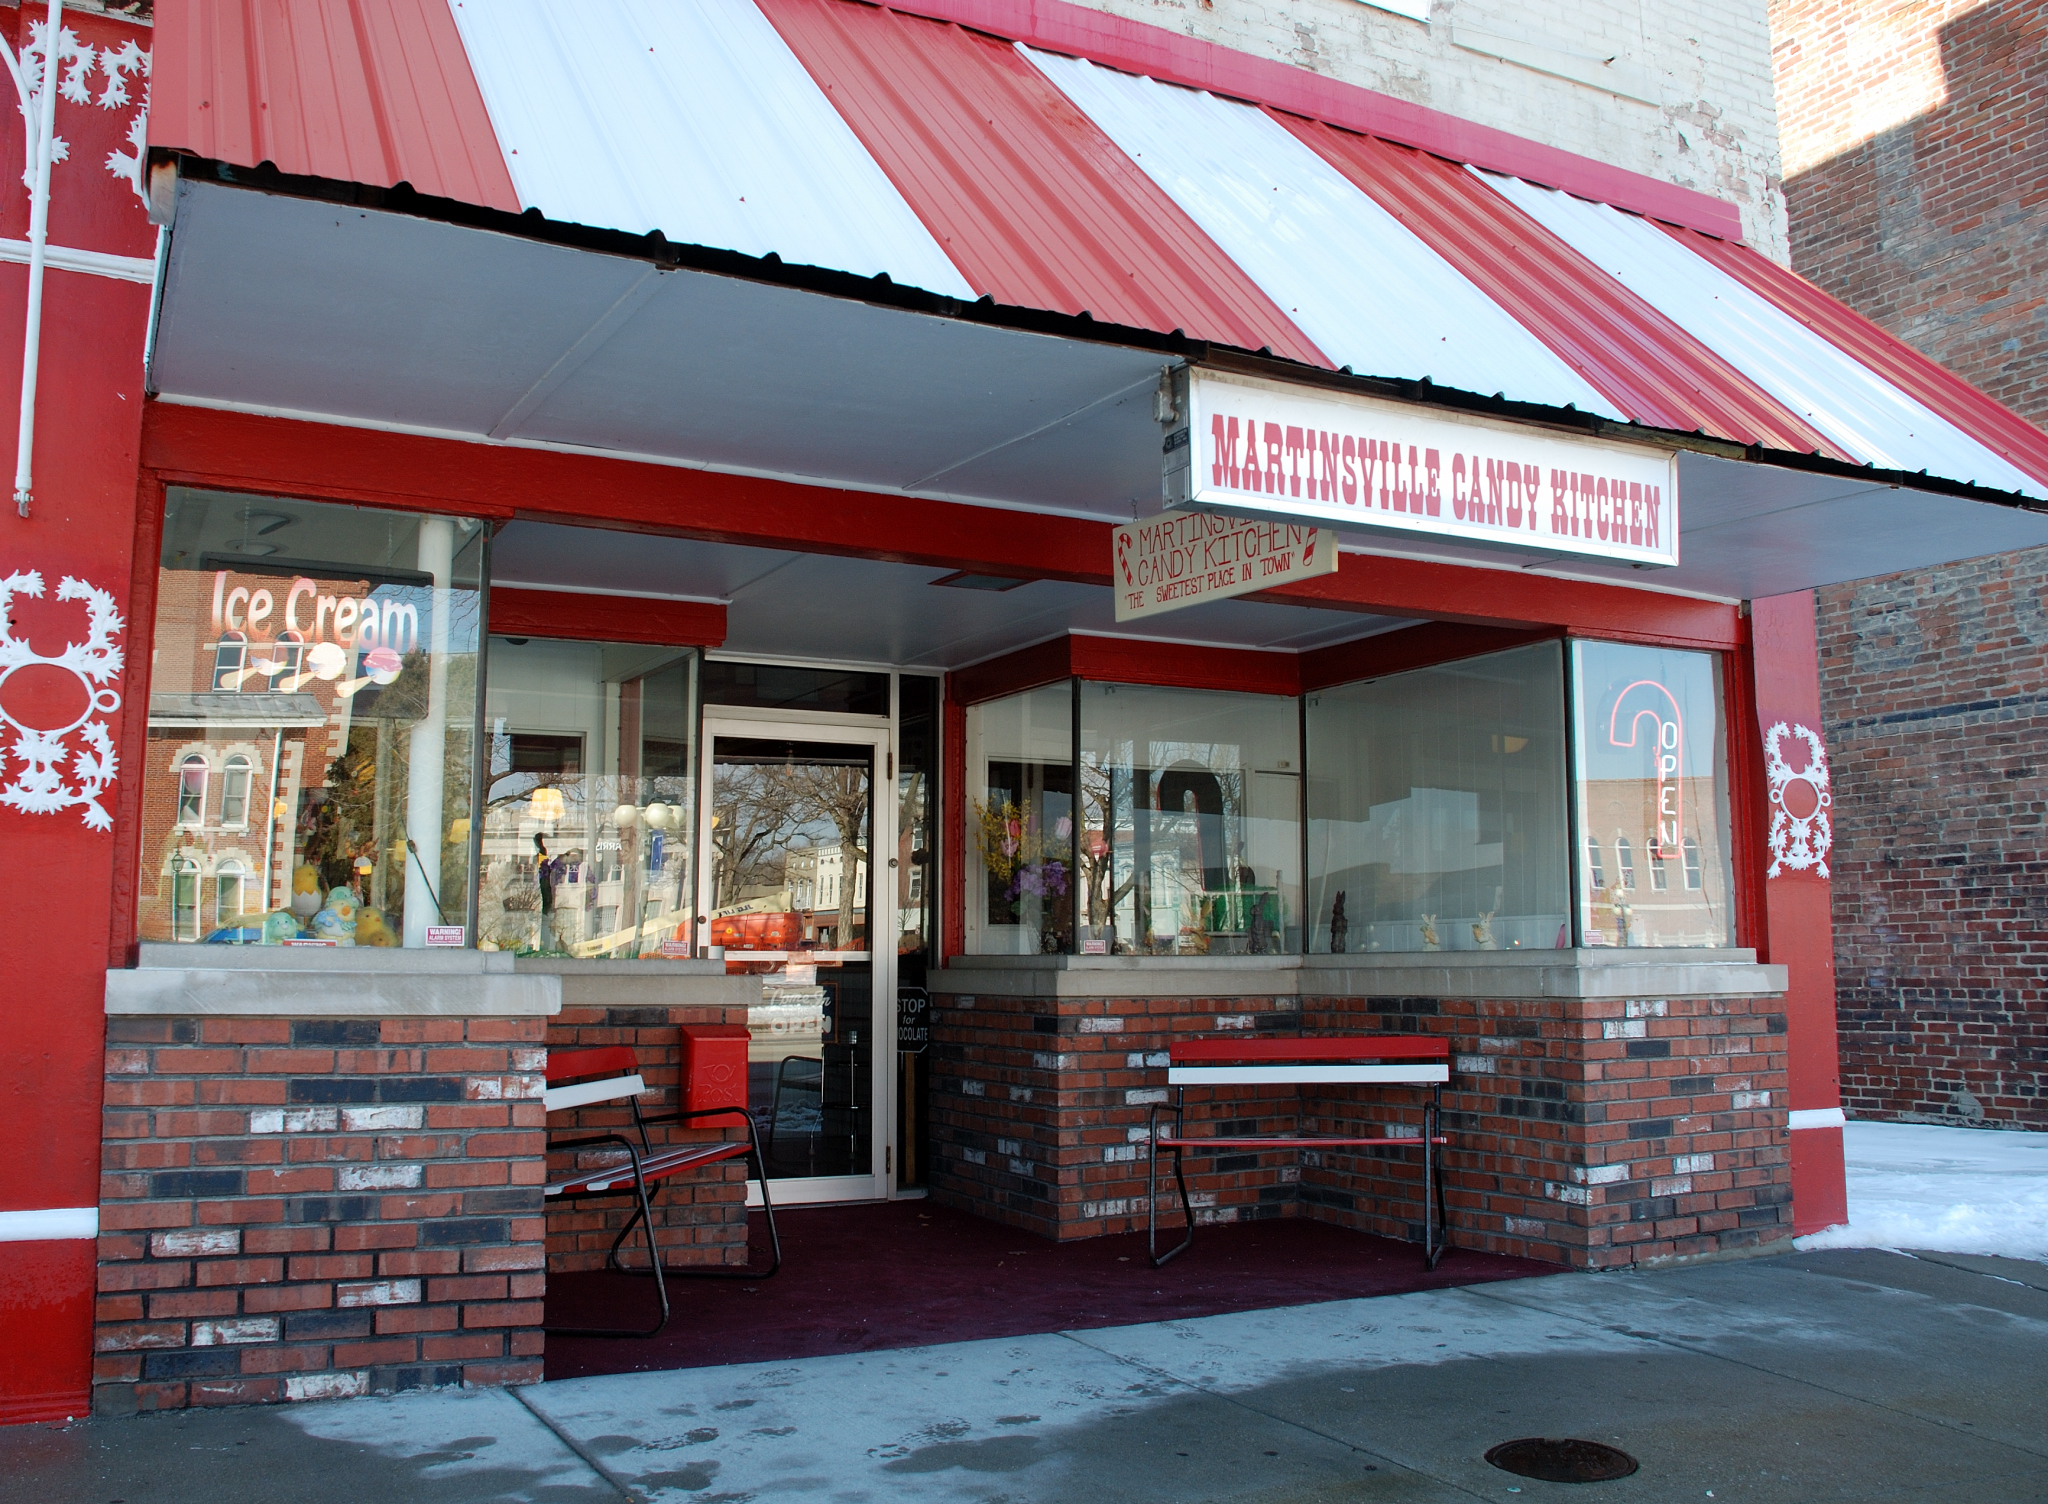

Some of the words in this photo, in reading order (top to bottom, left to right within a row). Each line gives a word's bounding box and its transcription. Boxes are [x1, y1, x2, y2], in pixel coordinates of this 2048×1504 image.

[1211, 413, 1441, 517] MARTINSVILLE
[1452, 452, 1540, 531] CANDY
[1551, 468, 1661, 549] KITCHEN
[1138, 544, 1198, 587] CANDY
[1204, 521, 1302, 570] KITCHEN
[1139, 513, 1258, 557] MARTINS
[1156, 575, 1205, 603] SWEETEST
[1207, 567, 1236, 591] PLACE
[1241, 561, 1252, 582] IN
[211, 570, 274, 640] Ice
[285, 577, 419, 655] Cream
[1660, 721, 1678, 846] OPEN
[429, 928, 462, 936] WARNING!
[770, 1014, 832, 1036] OPEN
[897, 998, 926, 1014] STOP
[902, 1015, 916, 1025] for
[897, 1026, 928, 1041] OCOLATE
